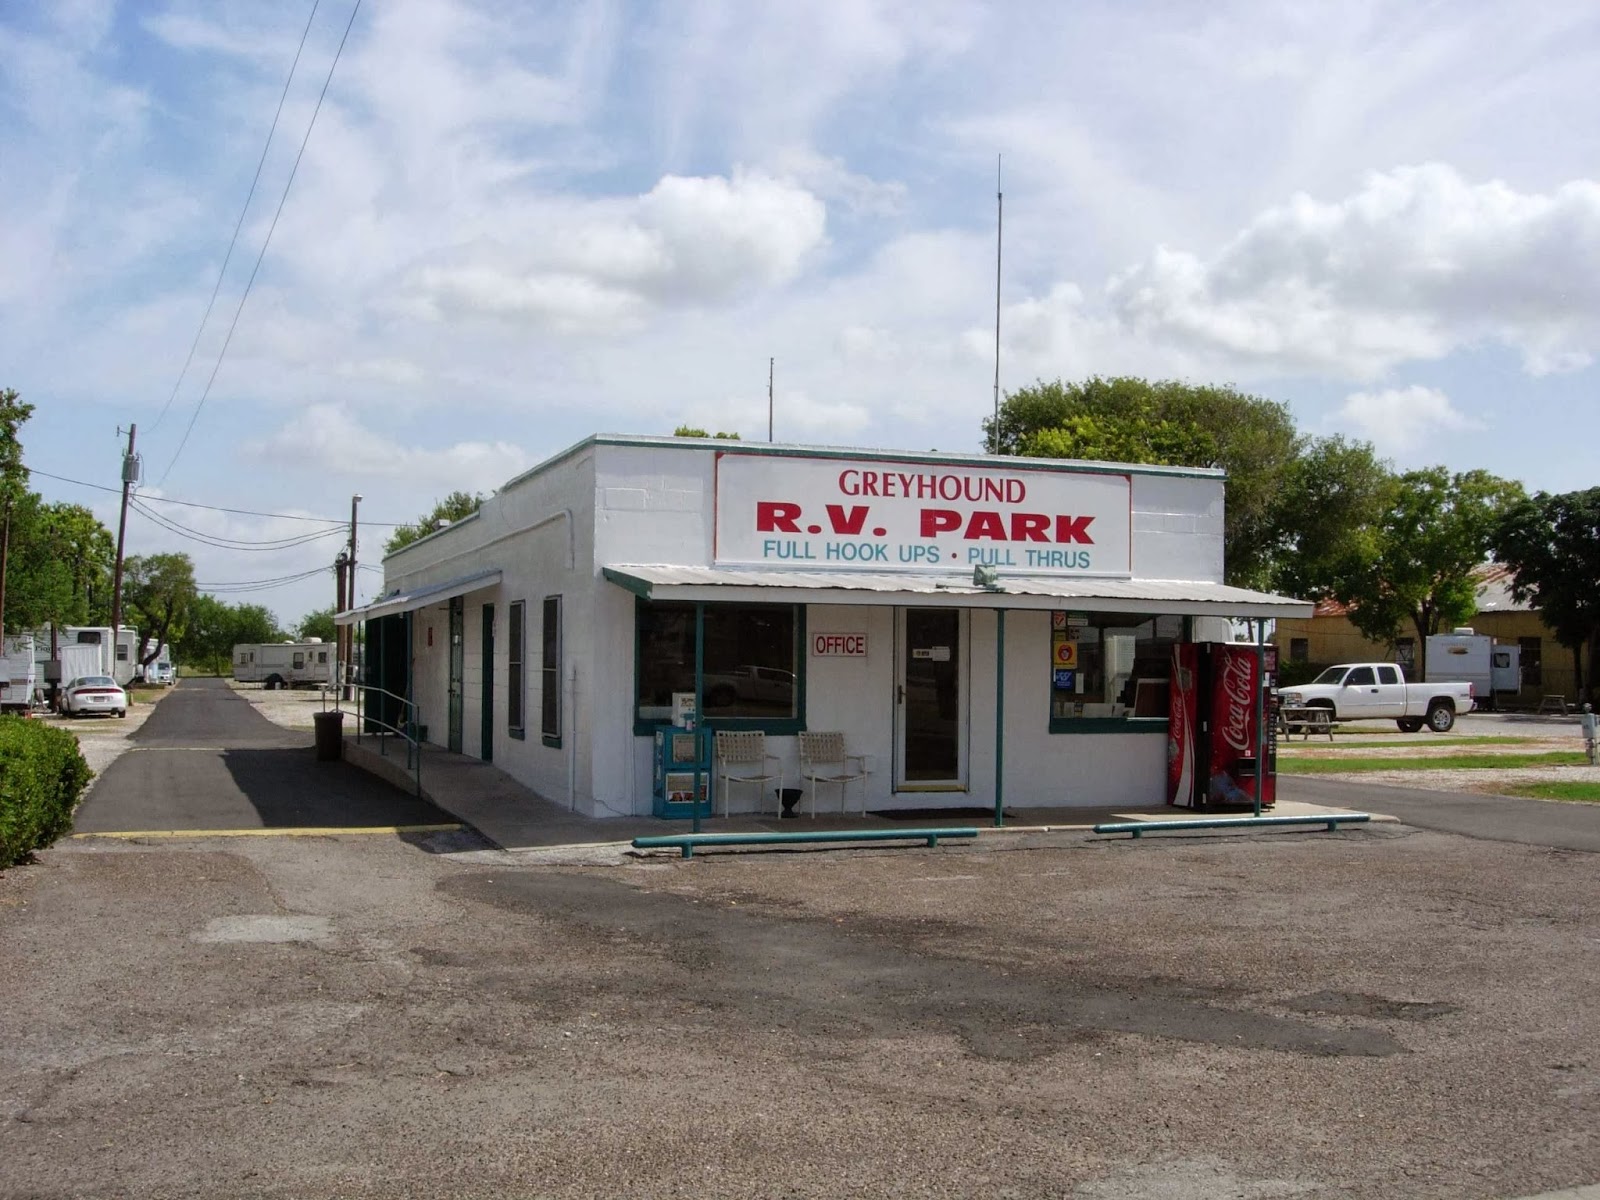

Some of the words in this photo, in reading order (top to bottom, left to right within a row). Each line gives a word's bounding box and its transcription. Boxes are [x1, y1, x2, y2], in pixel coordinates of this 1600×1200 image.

[838, 469, 1026, 504] GREYHOUND
[756, 501, 887, 537] R.V.
[920, 508, 1096, 545] PARK
[763, 540, 816, 559] FULL
[826, 542, 889, 562] HOOK
[899, 544, 940, 564] UPS
[968, 547, 1017, 567] PULL
[1025, 549, 1091, 569] THRUS
[815, 636, 864, 654] OFFICE
